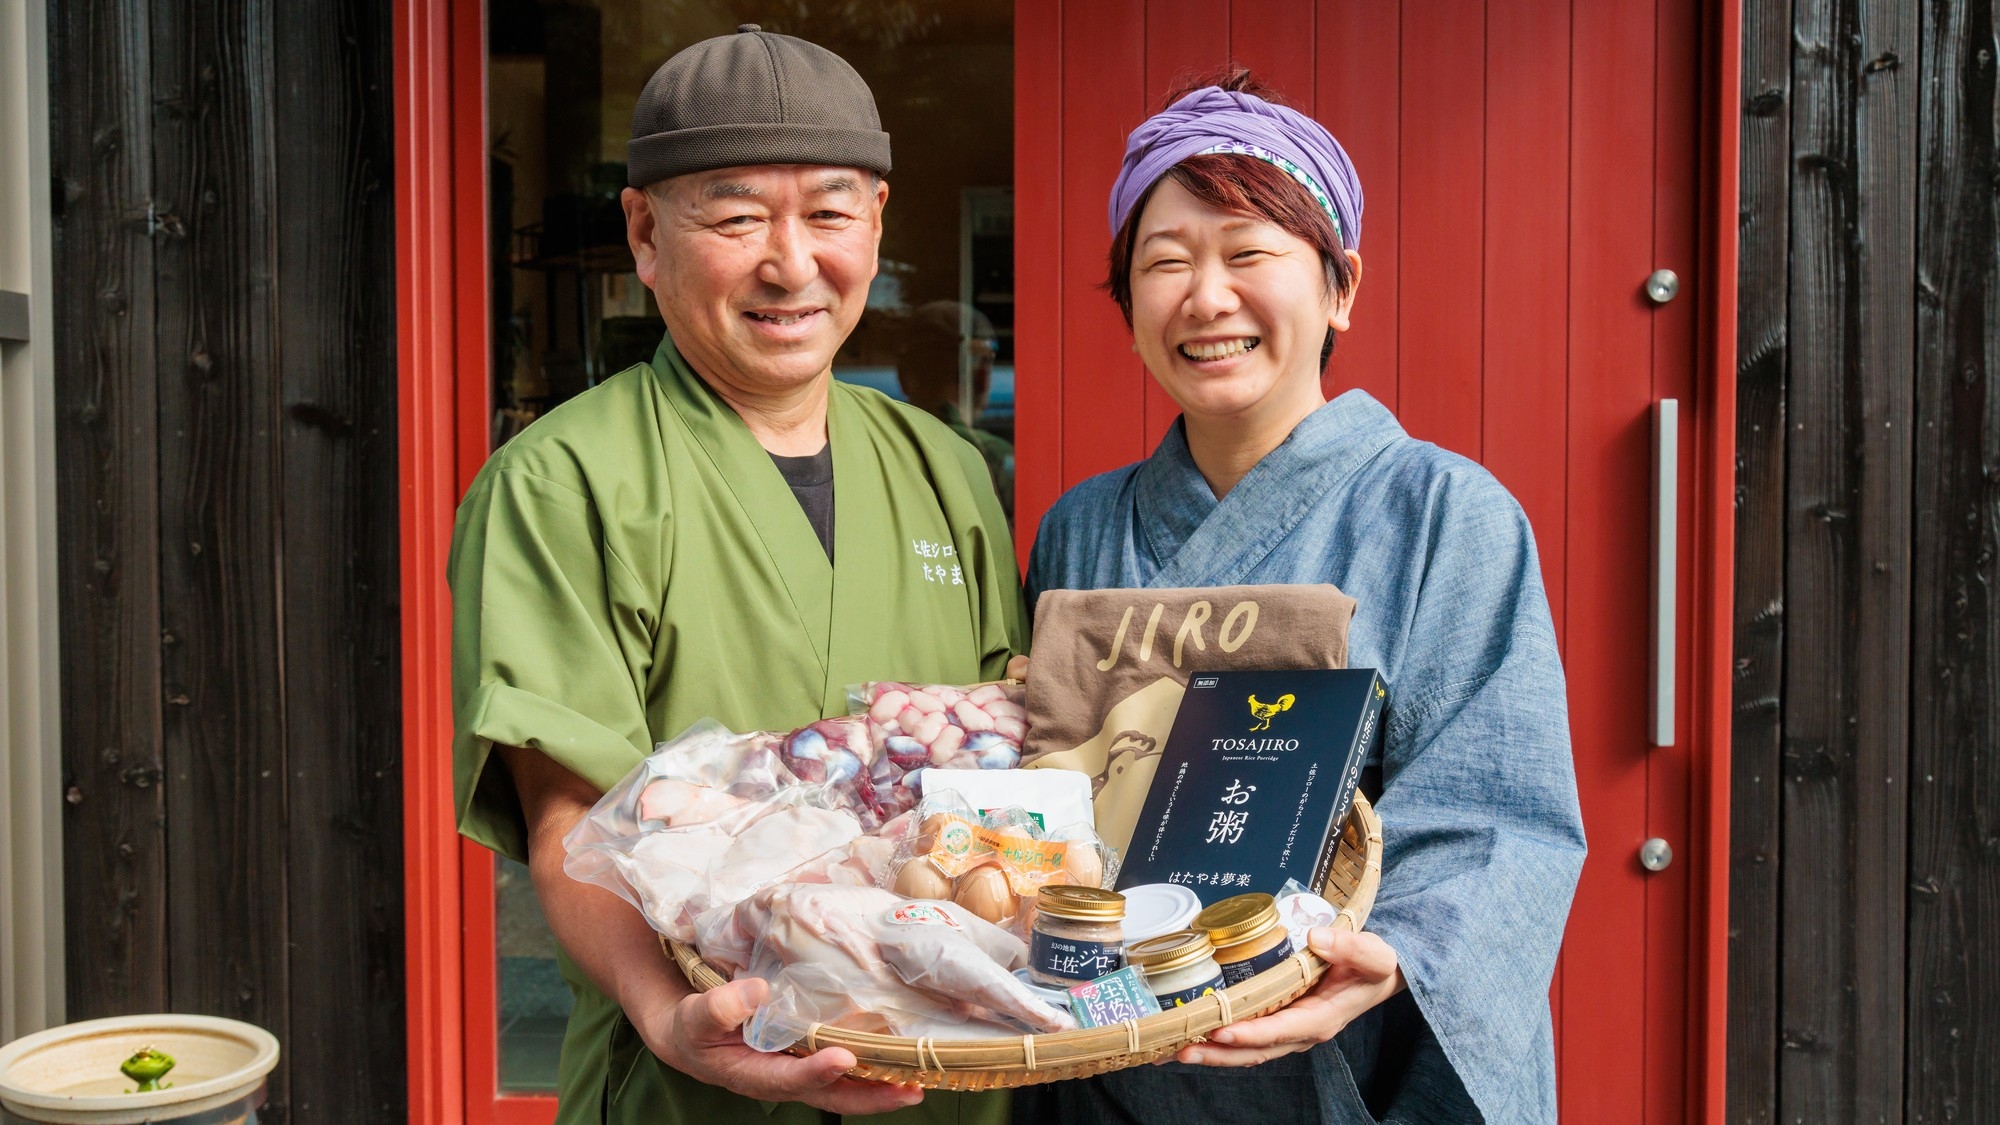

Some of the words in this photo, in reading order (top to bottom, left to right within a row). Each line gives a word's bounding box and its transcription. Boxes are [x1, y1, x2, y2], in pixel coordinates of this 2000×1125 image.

[1097, 600, 1260, 671] JIRO
[1211, 738, 1299, 753] TOSAJIRO
[1205, 779, 1257, 844] お粥
[1168, 871, 1252, 887] はたやま夢楽
[1050, 942, 1077, 953] 幻の地鶏
